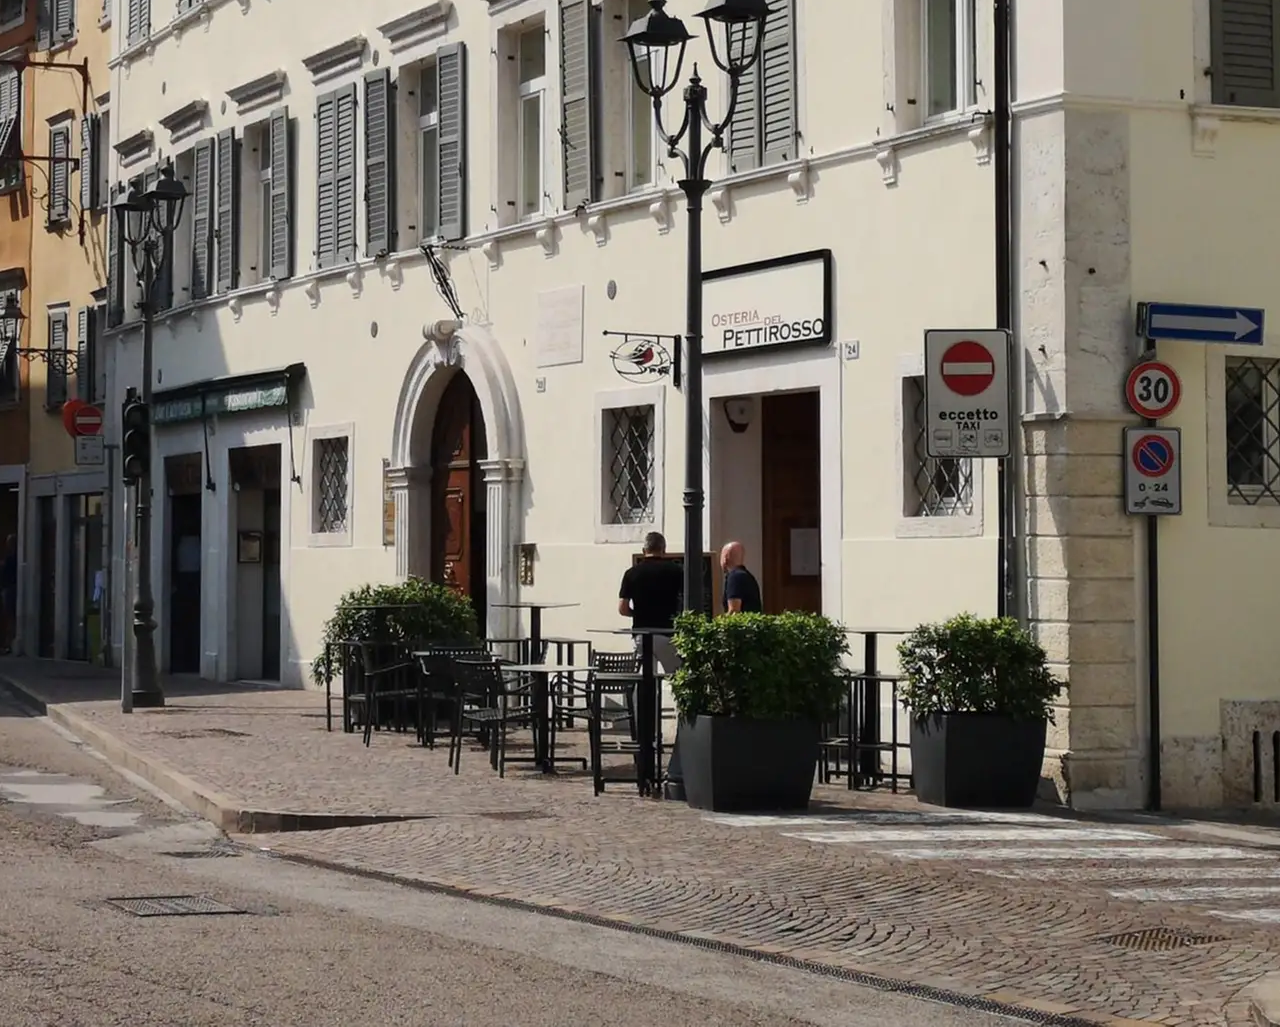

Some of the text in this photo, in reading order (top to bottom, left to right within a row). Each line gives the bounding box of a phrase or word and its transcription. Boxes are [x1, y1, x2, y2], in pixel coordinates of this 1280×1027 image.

[723, 318, 825, 348] PETTIROSSO
[1138, 376, 1169, 404] 30
[939, 408, 998, 421] eccetto
[956, 421, 980, 430] TAXI
